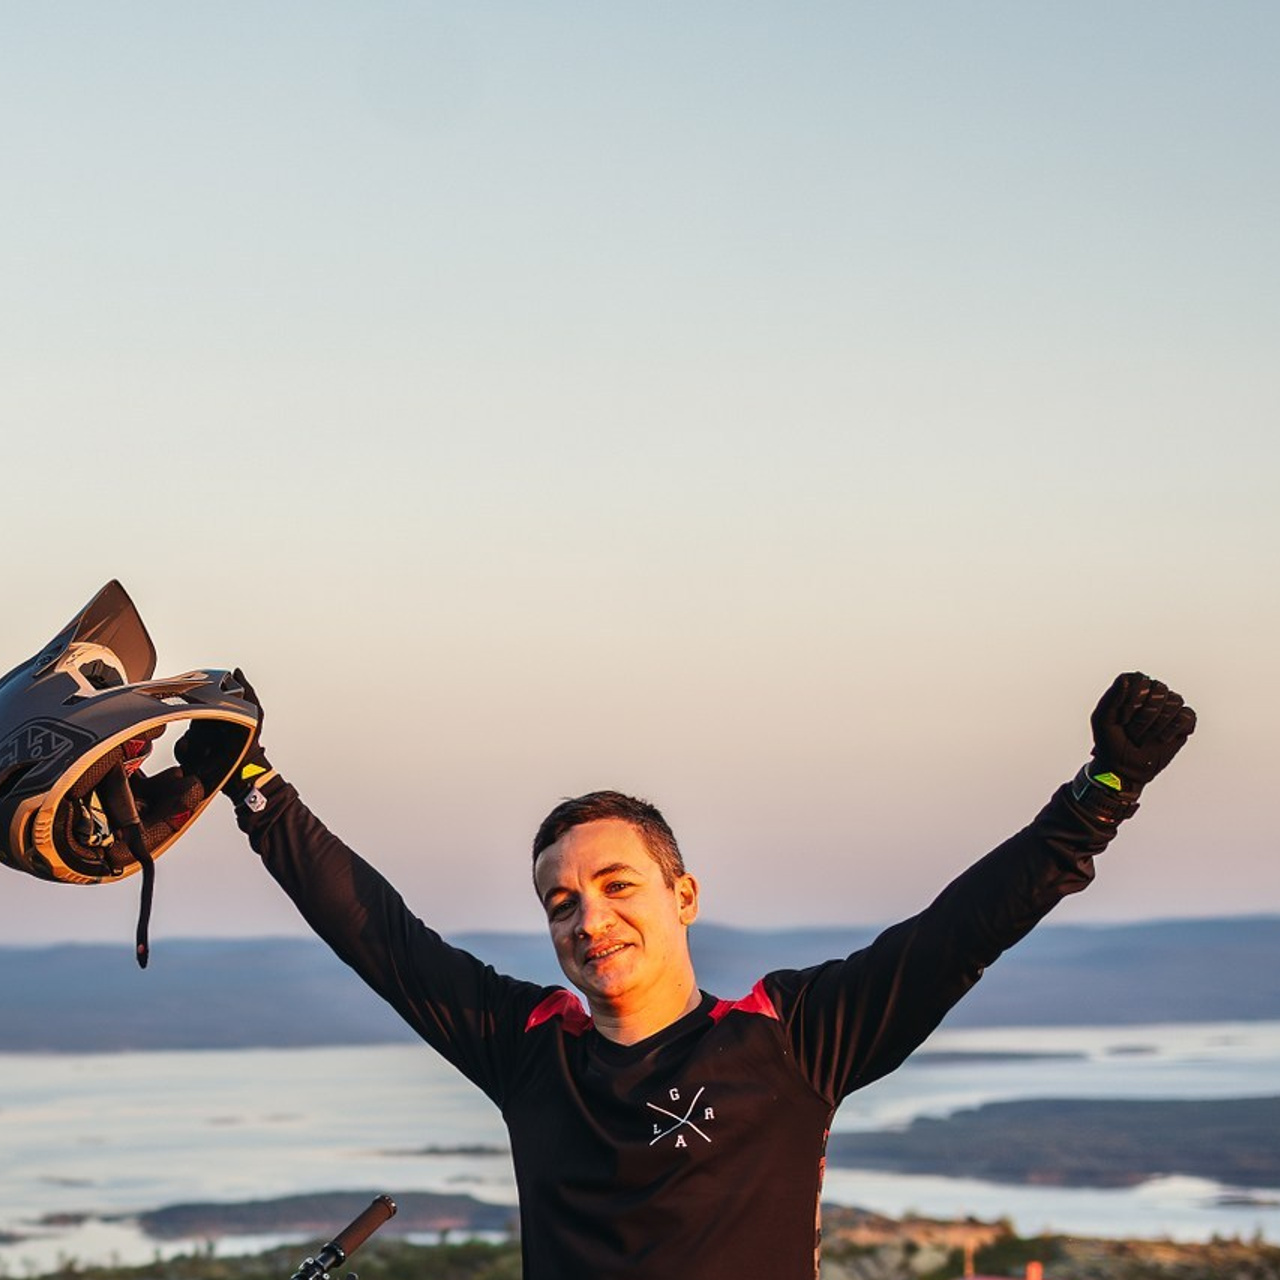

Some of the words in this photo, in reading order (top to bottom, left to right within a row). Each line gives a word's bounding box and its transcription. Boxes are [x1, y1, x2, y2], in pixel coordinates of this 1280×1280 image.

[669, 1087, 680, 1100] G
[704, 1107, 715, 1120] R
[653, 1124, 662, 1134] L
[674, 1135, 688, 1148] A
